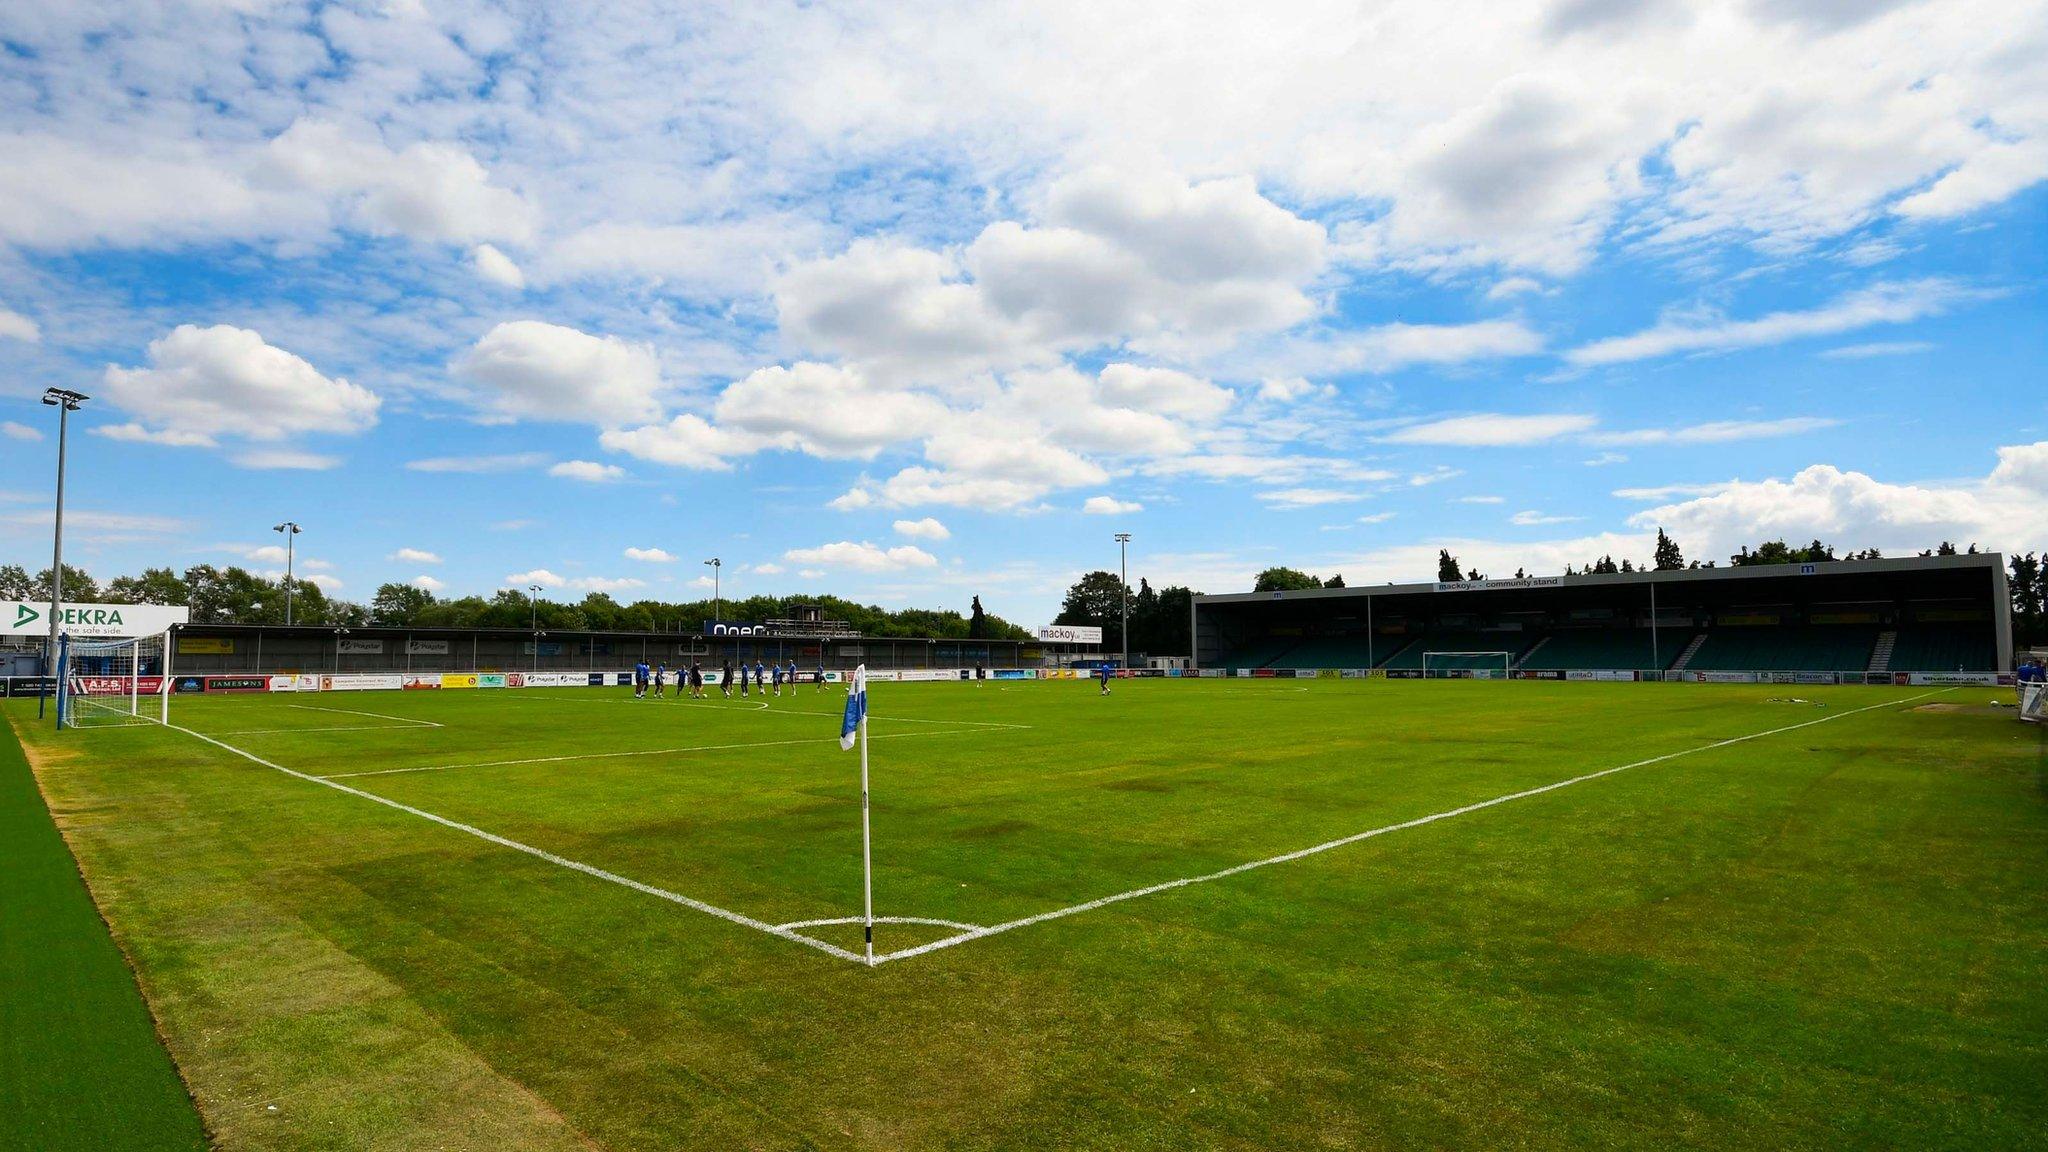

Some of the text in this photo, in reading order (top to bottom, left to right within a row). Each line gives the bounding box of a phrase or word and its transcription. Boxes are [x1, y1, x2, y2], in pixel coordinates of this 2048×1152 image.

[1439, 582, 1471, 590] mackoy
[1486, 578, 1531, 588] community
[1533, 577, 1558, 585] stand
[66, 626, 79, 634] the
[83, 626, 100, 634] safe
[1040, 628, 1075, 641] mackoy
